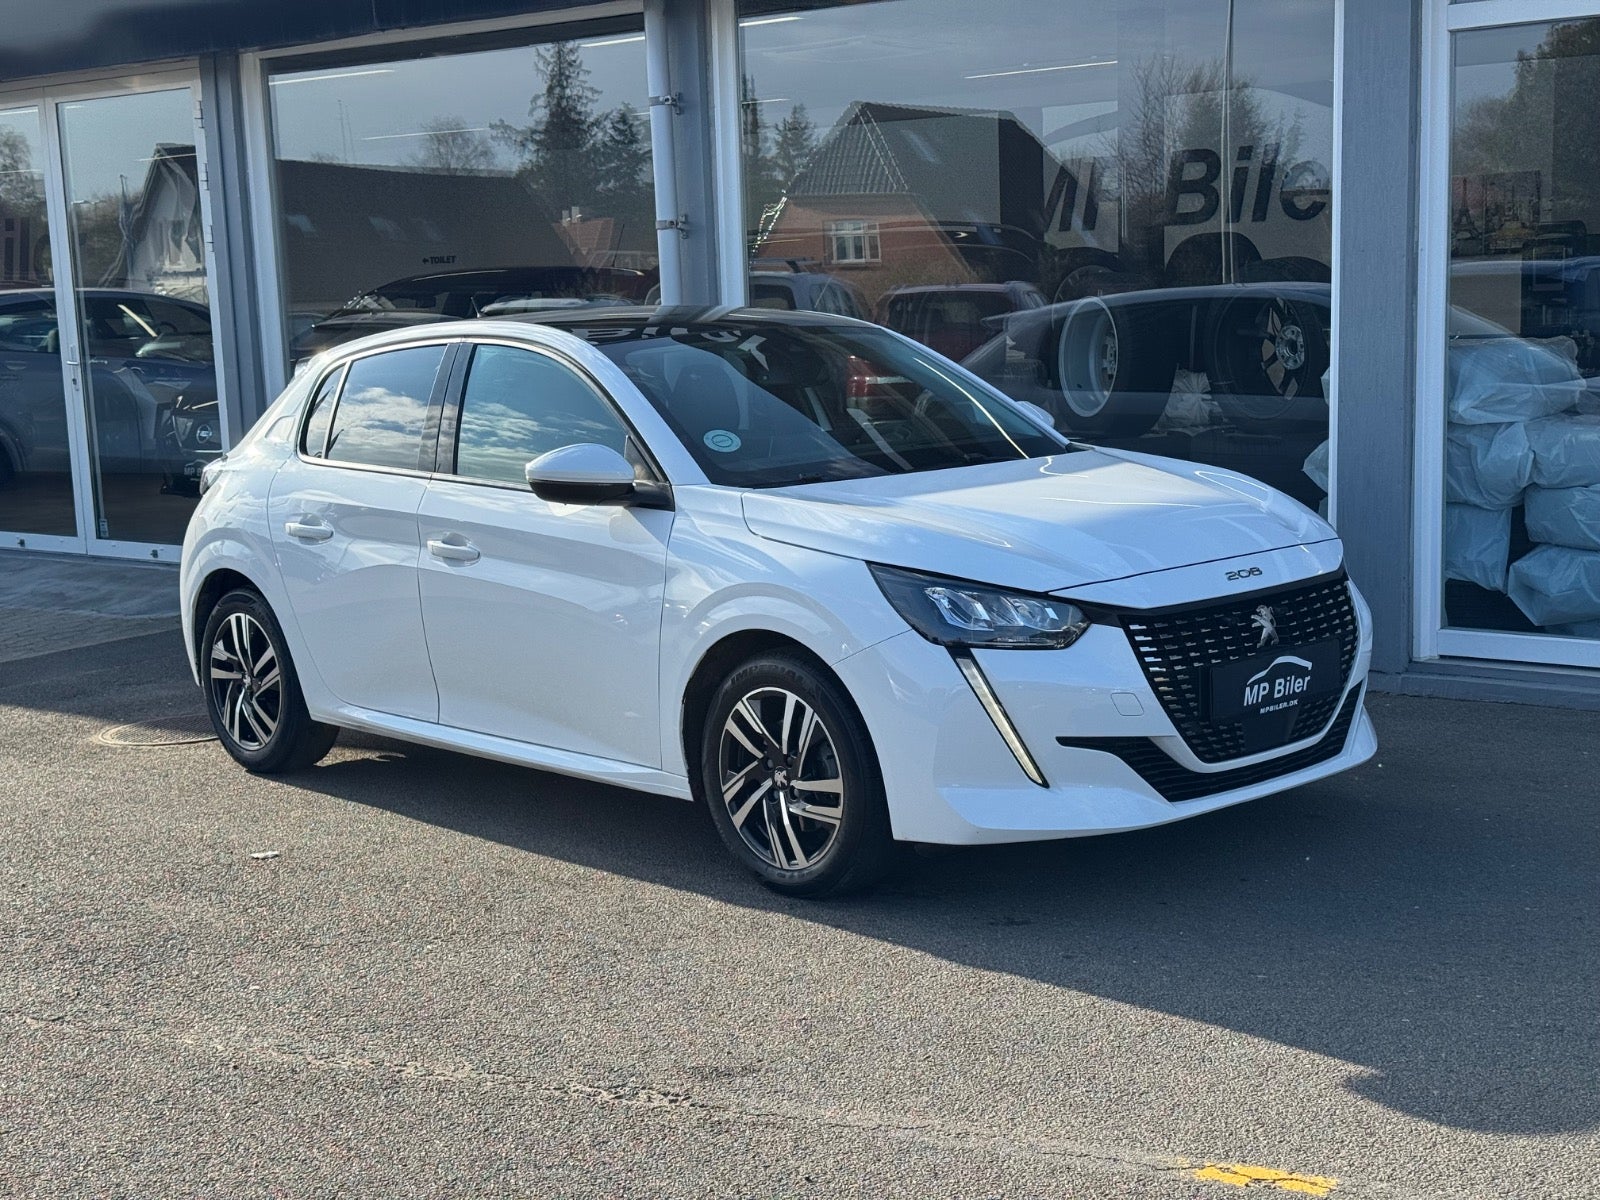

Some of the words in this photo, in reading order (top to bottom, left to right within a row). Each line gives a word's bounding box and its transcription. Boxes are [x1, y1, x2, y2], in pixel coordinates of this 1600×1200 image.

[429, 255, 456, 264] TOILET
[1225, 567, 1263, 581] 208
[1243, 682, 1270, 706] MP
[1273, 675, 1311, 699] Biler
[1260, 699, 1299, 713] MPBILER.DK
